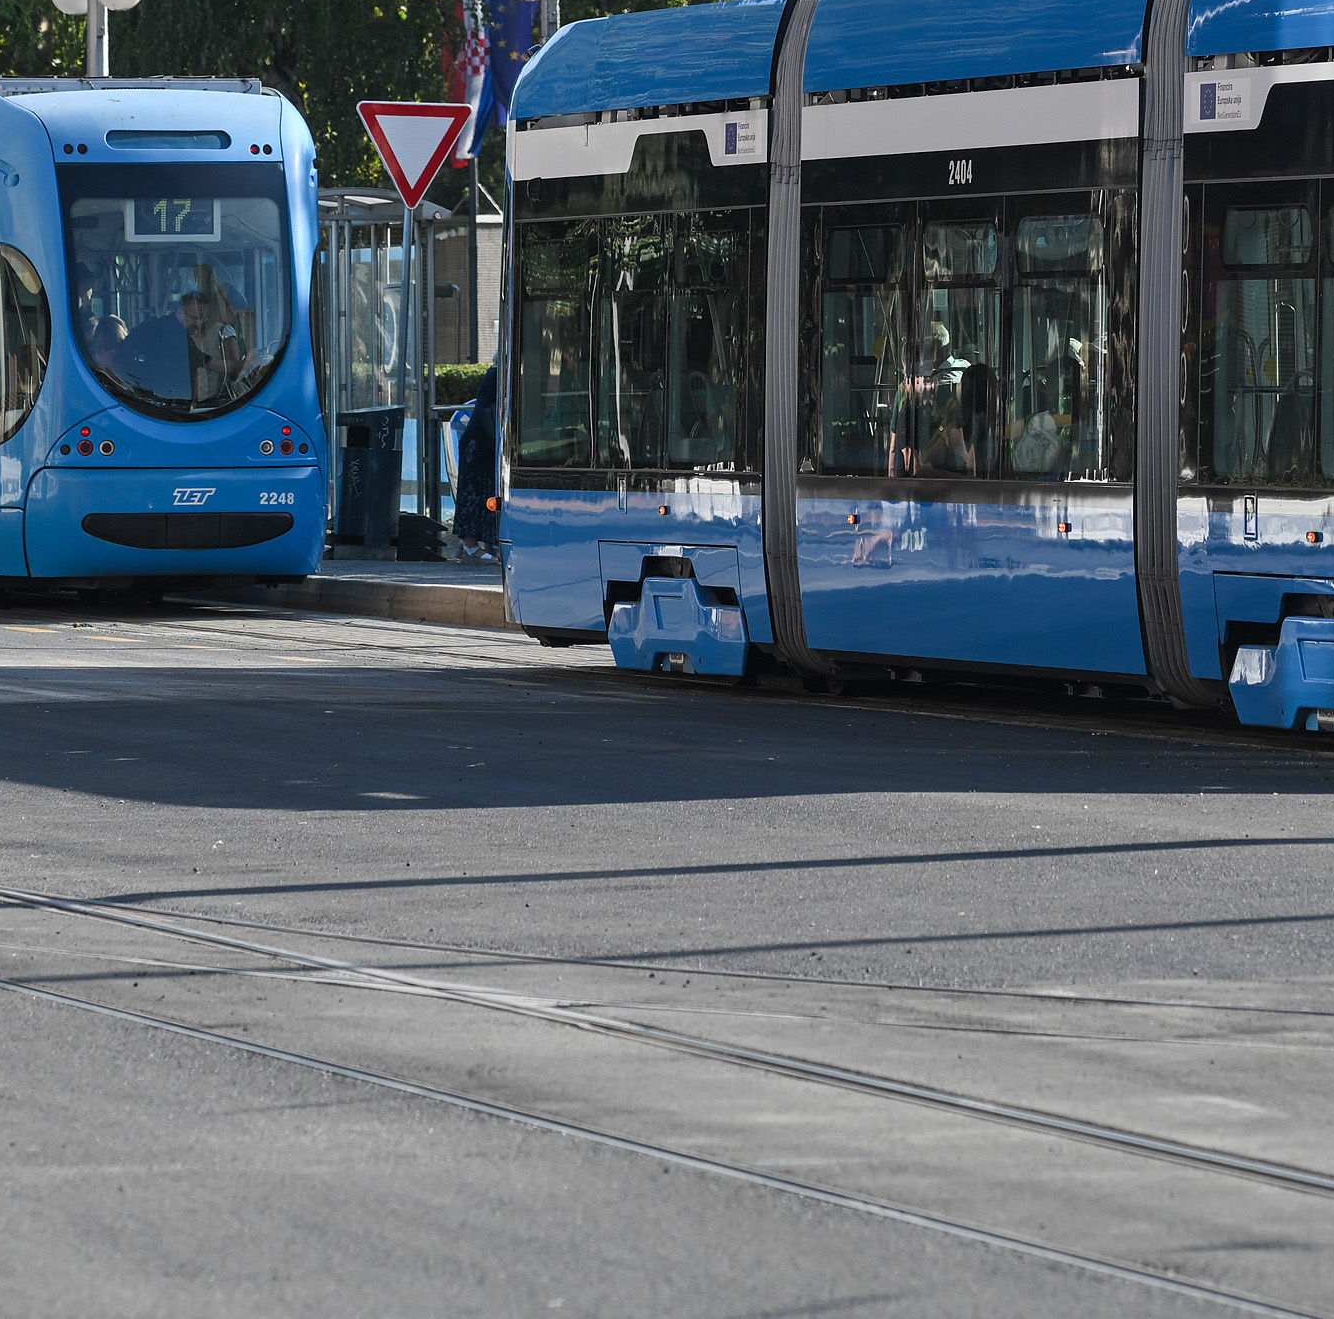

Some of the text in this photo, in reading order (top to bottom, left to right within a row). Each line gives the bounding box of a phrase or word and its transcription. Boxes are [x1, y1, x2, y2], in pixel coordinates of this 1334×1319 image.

[948, 159, 973, 185] 2404
[153, 198, 191, 232] 17
[172, 487, 217, 506] ZET
[259, 492, 295, 505] 2248
